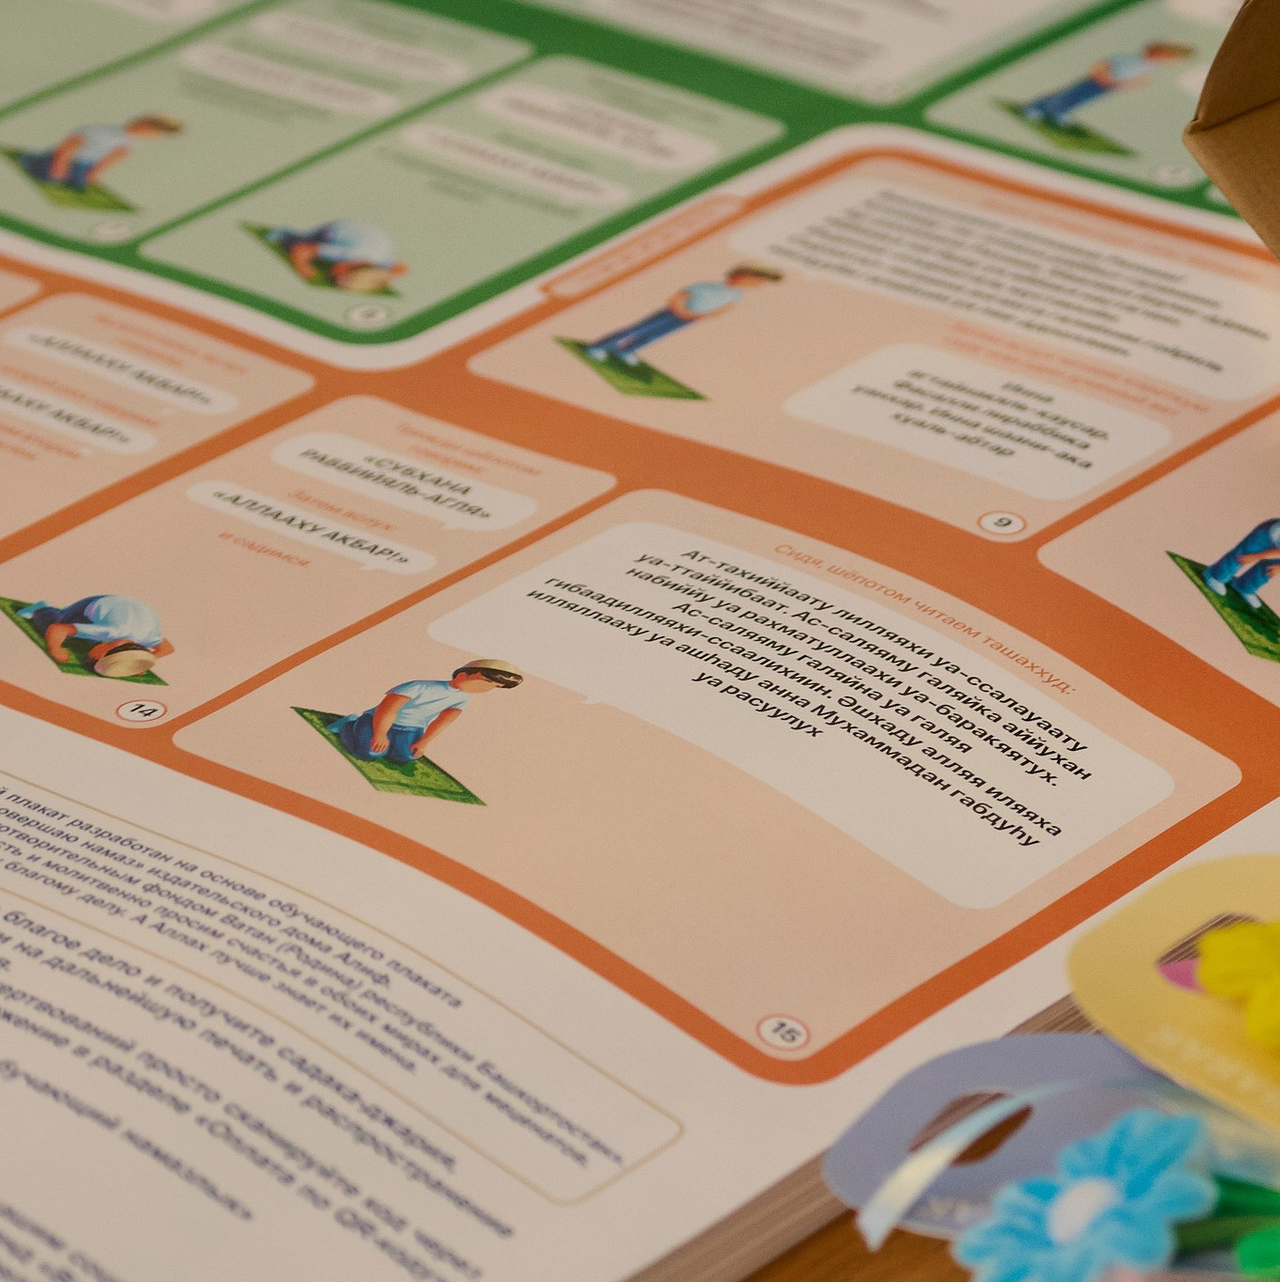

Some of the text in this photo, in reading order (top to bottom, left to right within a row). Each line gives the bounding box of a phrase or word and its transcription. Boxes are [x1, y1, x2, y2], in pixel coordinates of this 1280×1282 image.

[321, 530, 410, 564] АКБАР!»
[625, 568, 1060, 789] набиййу уа рахматуллаахи уа-баракяятух.
[634, 553, 1092, 780] уа-ттаййибаат. Ас-саляяму галяйка аййухан
[670, 602, 973, 754] Ас-саляяму галяйна уа галяя
[680, 550, 1088, 751] Ат-тахиййаату лилляяхи уа-ссалауаату
[776, 544, 1077, 694] Сидя, шёпотом читаем ташаххуд:
[129, 702, 156, 719] 14
[526, 589, 650, 637] илляллааху
[644, 633, 676, 648] уа
[758, 680, 811, 708] анна
[810, 704, 952, 792] Мухаммадан
[544, 577, 832, 699] гибаадилляяхи-ссаалихиин.
[922, 747, 987, 789] алляя
[984, 787, 1063, 838] иляяха
[691, 672, 825, 738] уа расуулух
[0, 806, 79, 844] овершаю
[80, 840, 145, 870] намаз»
[146, 867, 282, 927] издательского
[278, 925, 334, 955] дома
[0, 823, 142, 886] отворительным
[141, 882, 220, 919] фондом
[218, 912, 278, 946] Ватан
[4, 860, 81, 896] благому
[130, 913, 149, 926] А
[148, 920, 210, 953] Аллах
[6, 793, 70, 821] плакат
[65, 819, 174, 863] разработан
[173, 859, 199, 874] на
[200, 870, 267, 901] основе
[267, 899, 385, 961] обучающего
[26, 853, 43, 864] и
[41, 860, 153, 909] молитвенно
[153, 905, 227, 941] просим
[3, 909, 82, 952] благое
[78, 946, 143, 978] дело
[143, 974, 165, 988] и
[12, 940, 45, 960] на
[771, 1020, 801, 1044] 15
